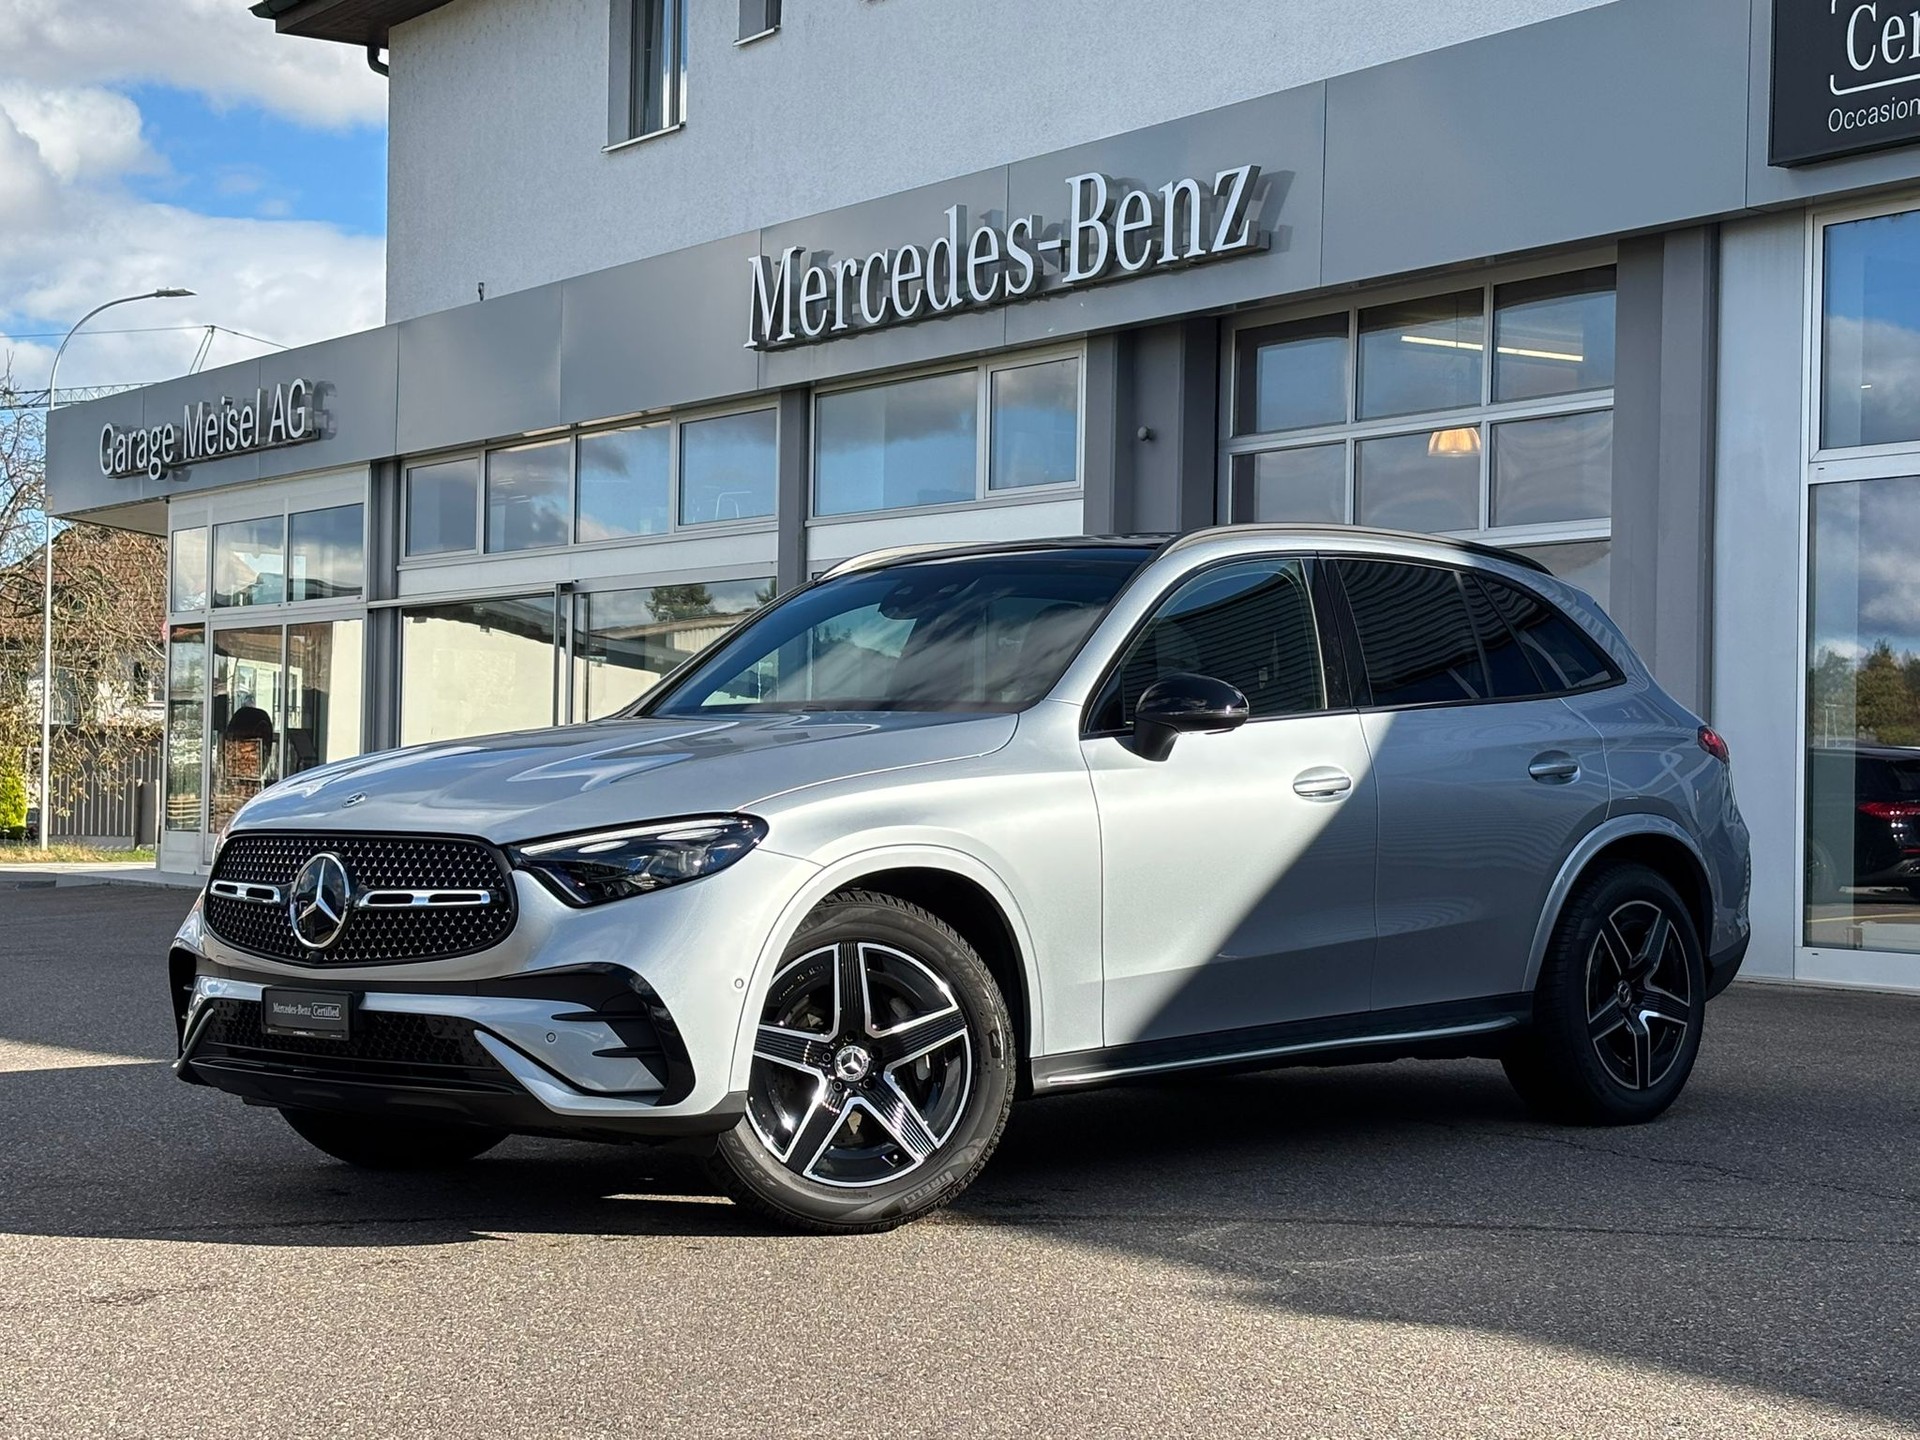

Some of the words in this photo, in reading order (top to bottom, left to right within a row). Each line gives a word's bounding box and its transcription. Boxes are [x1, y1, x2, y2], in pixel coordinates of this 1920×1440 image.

[1828, 97, 1920, 132] Occasion
[743, 164, 1262, 349] Mercedes-Benz
[99, 422, 175, 480] Garage
[183, 387, 262, 459] Meisel
[269, 378, 306, 442] AG
[272, 1002, 312, 1016] Mercedes-Benz
[313, 1005, 340, 1018] Certified
[903, 1170, 955, 1208] PIRELLI
